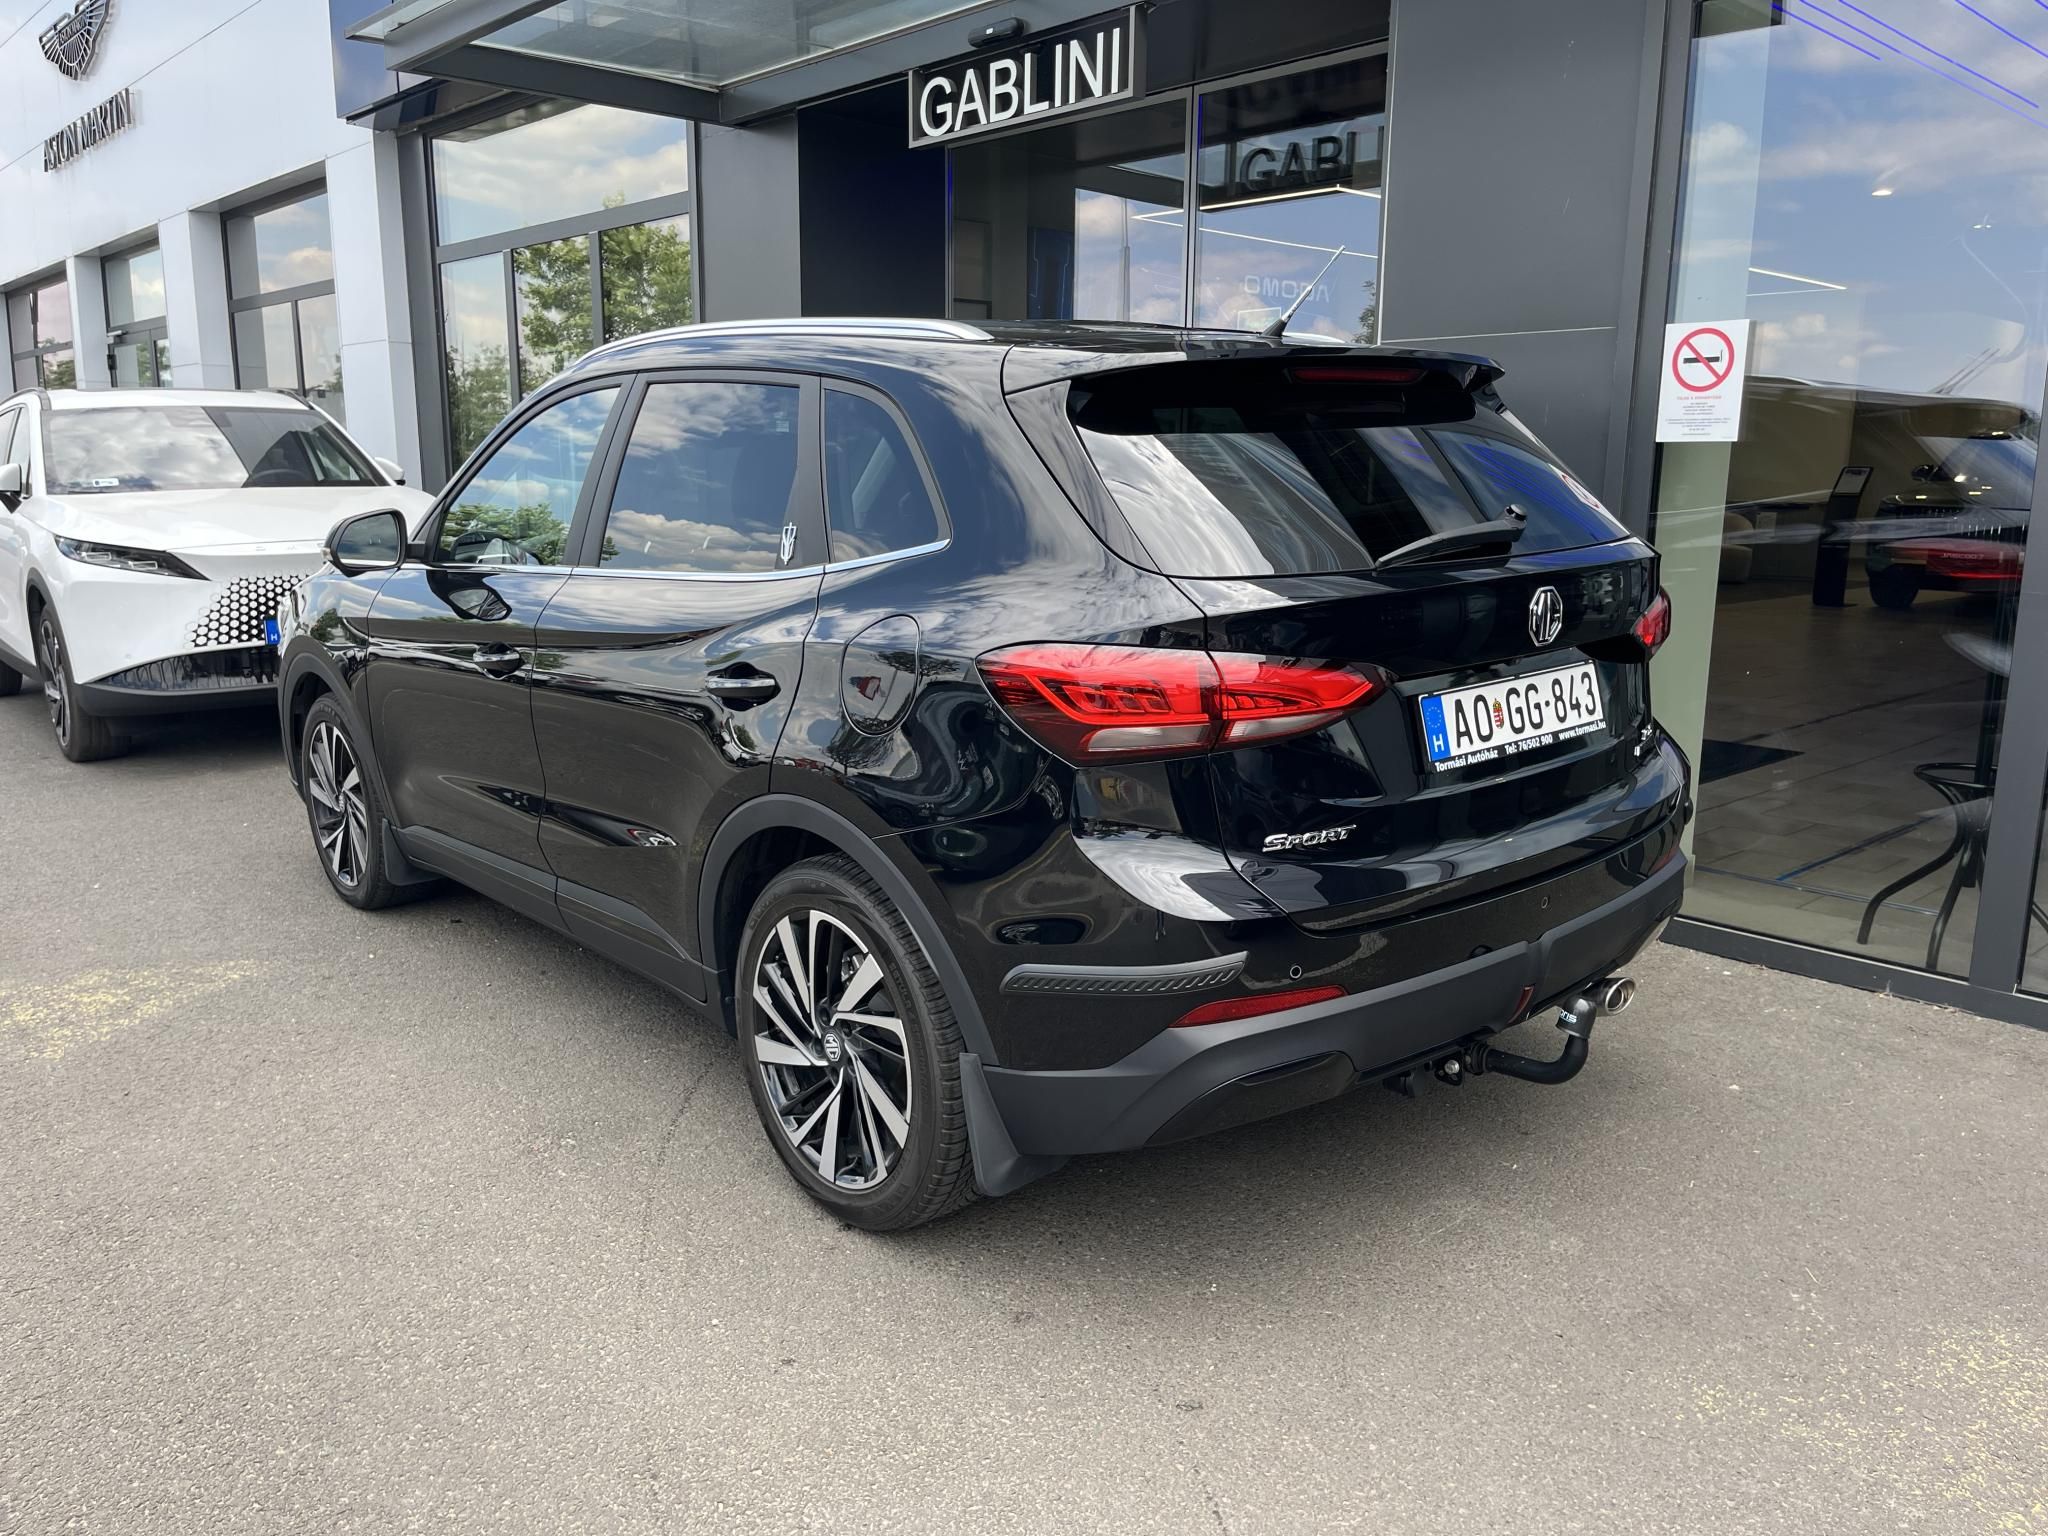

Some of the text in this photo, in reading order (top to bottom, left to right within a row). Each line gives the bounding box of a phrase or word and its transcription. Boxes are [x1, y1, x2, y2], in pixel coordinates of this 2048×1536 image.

[919, 27, 1121, 137] GABLINI
[44, 87, 132, 172] ASTON MARTIN
[270, 633, 278, 642] H
[1432, 734, 1445, 754] H
[1434, 757, 1467, 773] Tormási
[1467, 748, 1499, 766] Autóház
[1558, 720, 1607, 741] www.tormasi.hu
[1262, 824, 1357, 853] SPORT
